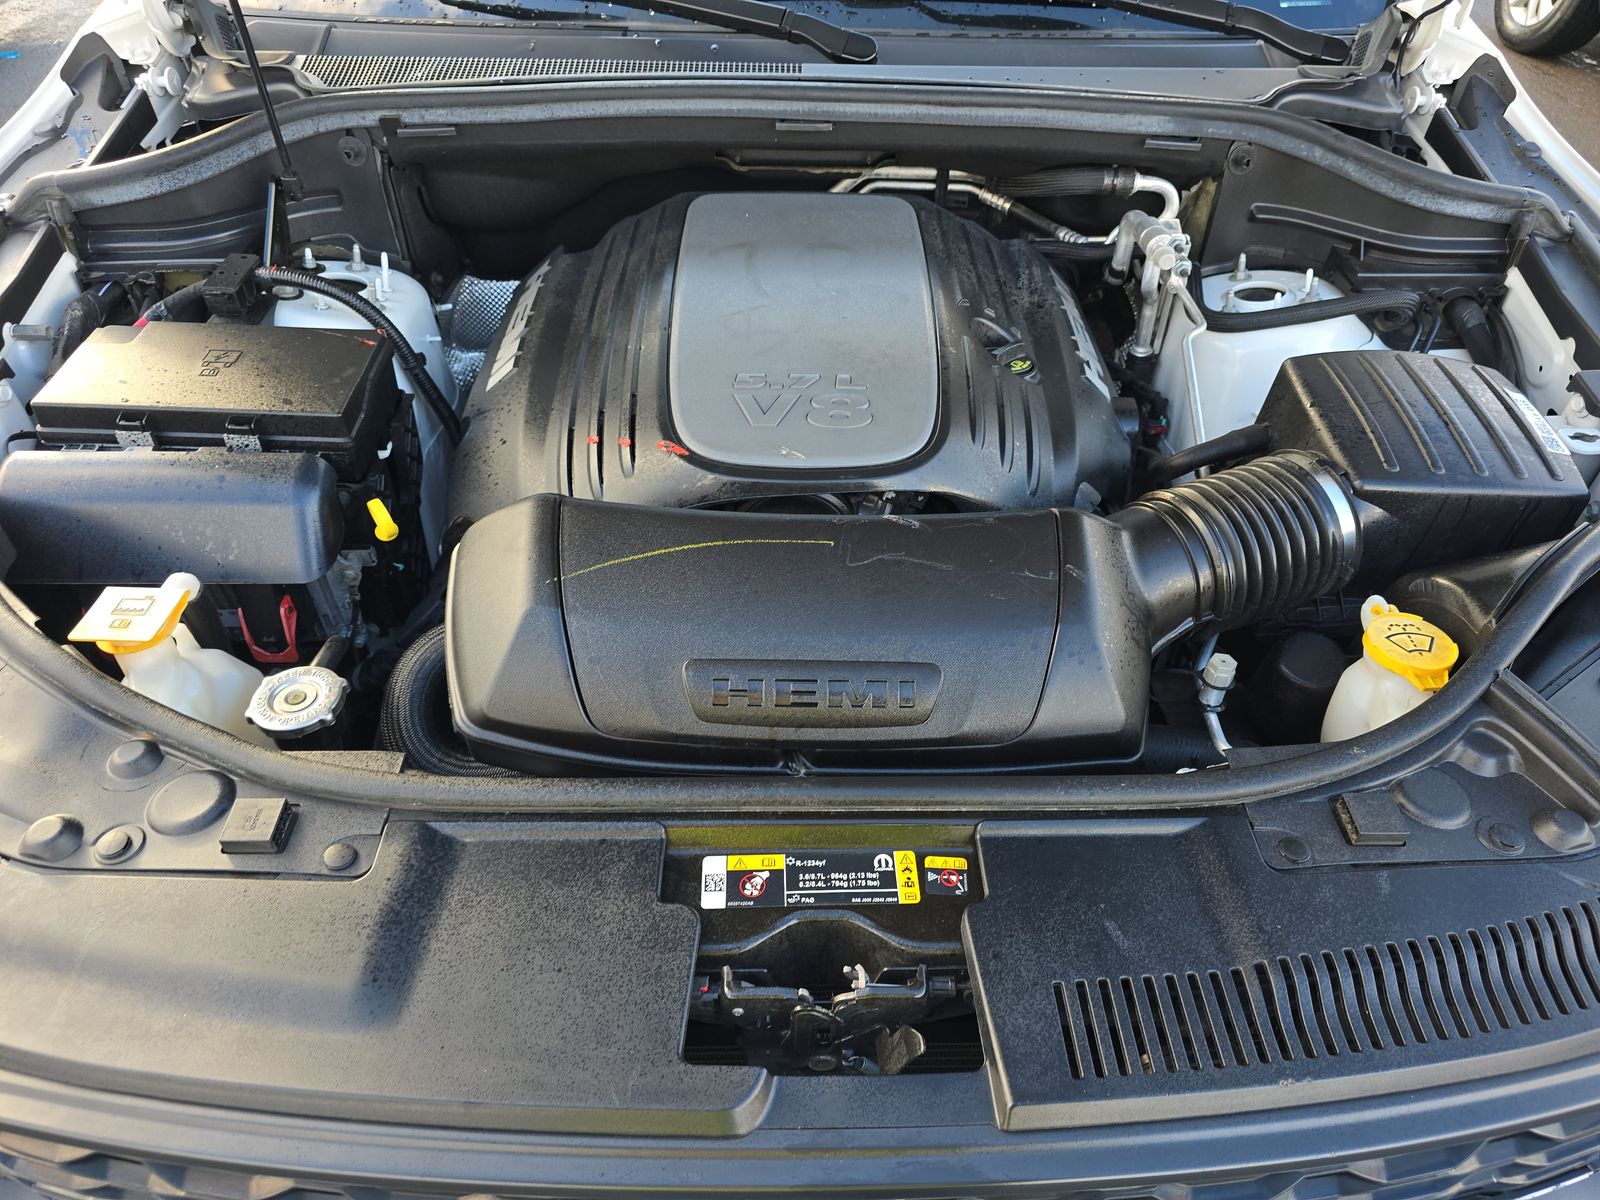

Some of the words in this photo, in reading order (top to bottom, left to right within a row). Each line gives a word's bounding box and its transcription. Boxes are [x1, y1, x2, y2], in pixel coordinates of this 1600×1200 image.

[732, 393, 874, 429] V8
[711, 678, 916, 708] HEMI
[796, 859, 826, 867] R-1234yf
